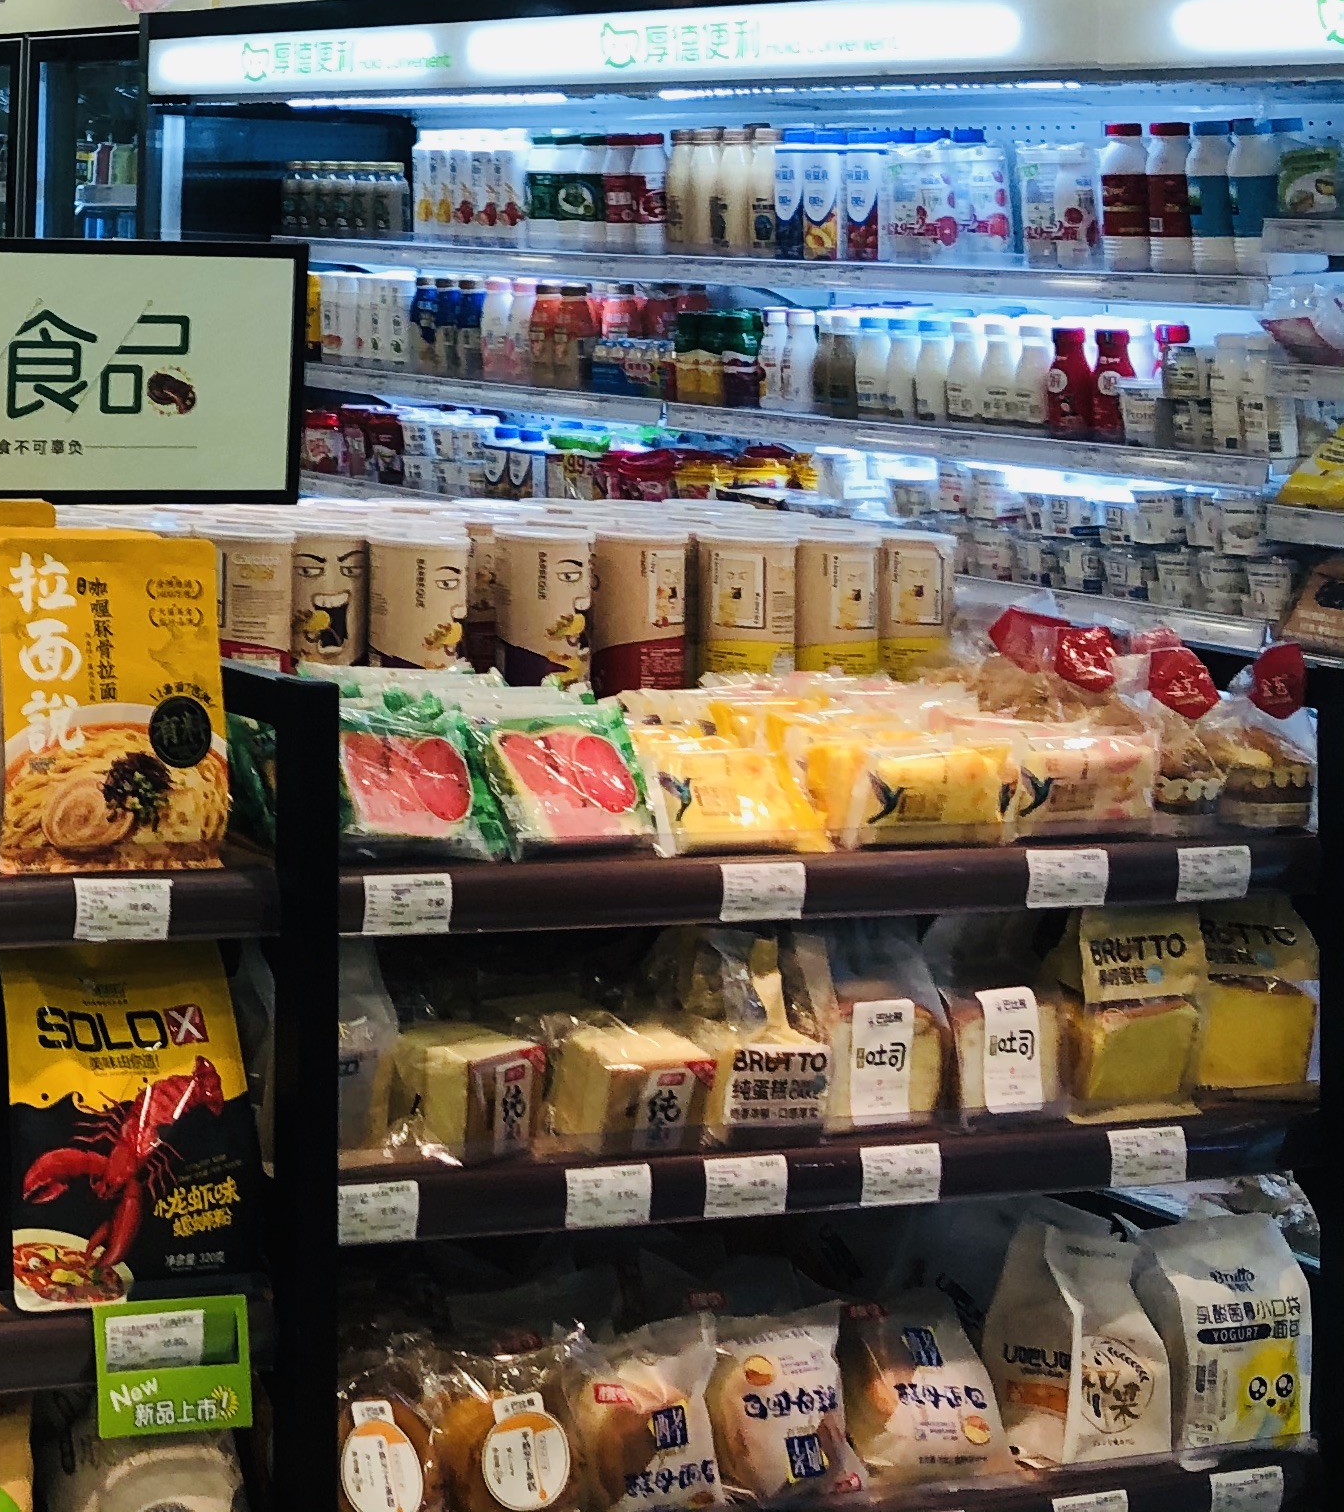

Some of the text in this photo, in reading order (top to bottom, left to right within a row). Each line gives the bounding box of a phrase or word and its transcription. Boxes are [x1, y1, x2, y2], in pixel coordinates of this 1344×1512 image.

[1090, 933, 1186, 966] BRUTTO
[865, 1041, 907, 1071] 吐司
[997, 1029, 1036, 1060] 吐司
[154, 1176, 240, 1219] 小龙虾味
[1212, 1327, 1259, 1342] YOGURT
